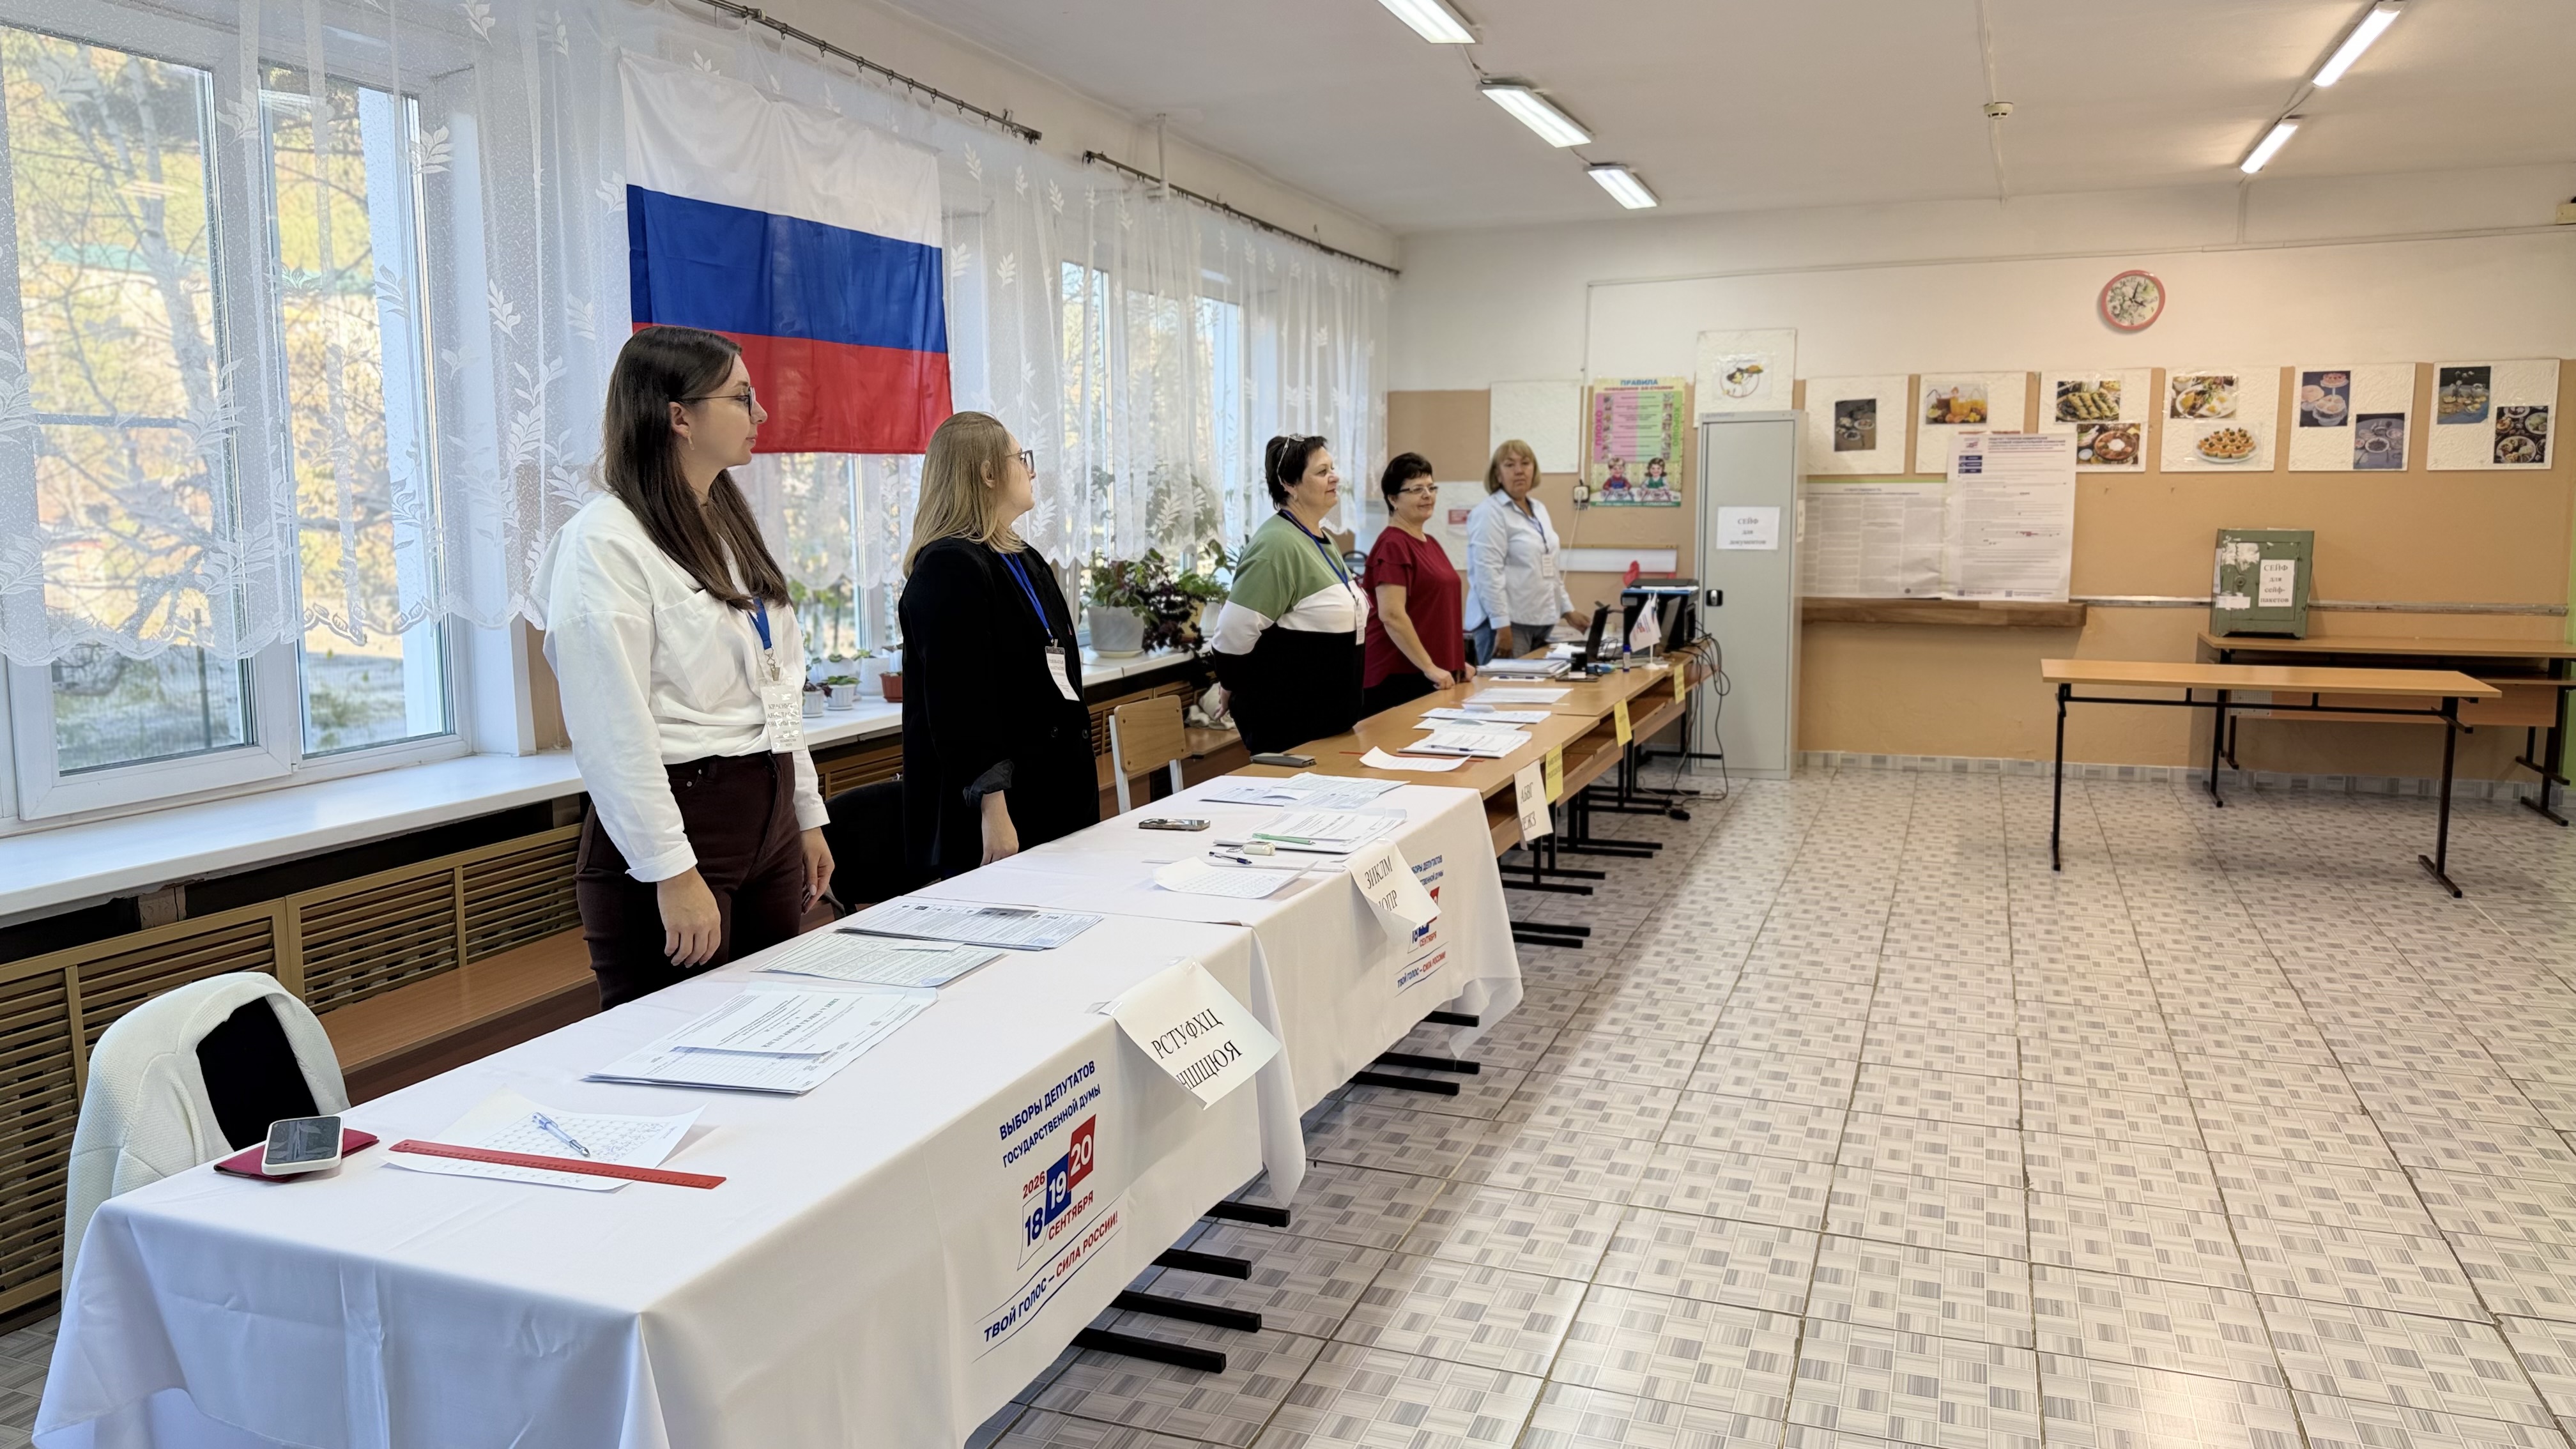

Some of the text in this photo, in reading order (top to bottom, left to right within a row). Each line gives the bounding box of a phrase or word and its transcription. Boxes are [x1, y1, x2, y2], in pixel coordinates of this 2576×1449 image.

[1365, 855, 1393, 889] ЗИКЛМ
[1378, 889, 1398, 912] ОПР
[1151, 1008, 1225, 1059] РСТУФХЦ
[1176, 1039, 1243, 1090] ЧШЩЮЯ
[999, 1061, 1095, 1140] ВЫБОРЫ ДЕПУТАТОВ
[1002, 1084, 1101, 1168] ГОСУДАРСТВЕННОЙ ДУМЫ
[1023, 1170, 1045, 1199] 2026
[1025, 1134, 1092, 1247] 18 19 20
[1048, 1190, 1094, 1241] СЕНТЯБРЯ
[984, 1307, 1016, 1342] ТВОЙ
[1018, 1276, 1047, 1319] ГОЛОС
[1056, 1245, 1081, 1278] СИЛА
[1082, 1211, 1119, 1255] РОССИИ!
